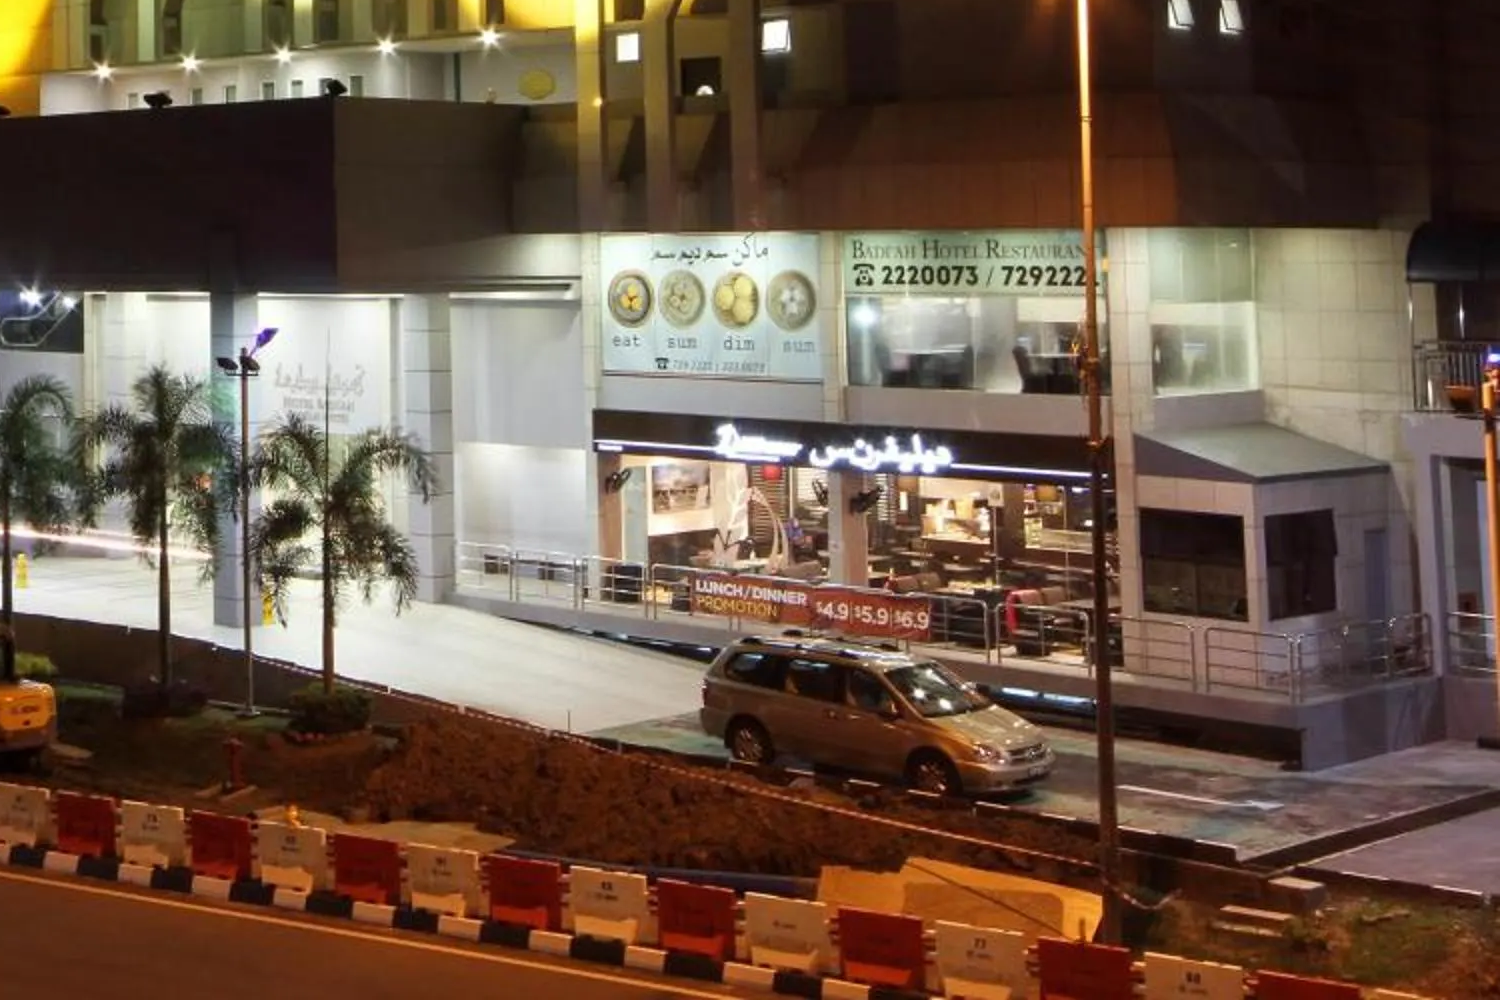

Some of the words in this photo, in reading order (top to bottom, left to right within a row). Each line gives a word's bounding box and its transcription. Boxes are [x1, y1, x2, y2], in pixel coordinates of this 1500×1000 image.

[985, 239, 1089, 260] RESTAURAN
[881, 265, 979, 286] 2220073
[1001, 265, 1100, 287] 729222
[612, 334, 642, 347] eat
[723, 335, 755, 351] dim
[697, 594, 778, 617] PROMOTION
